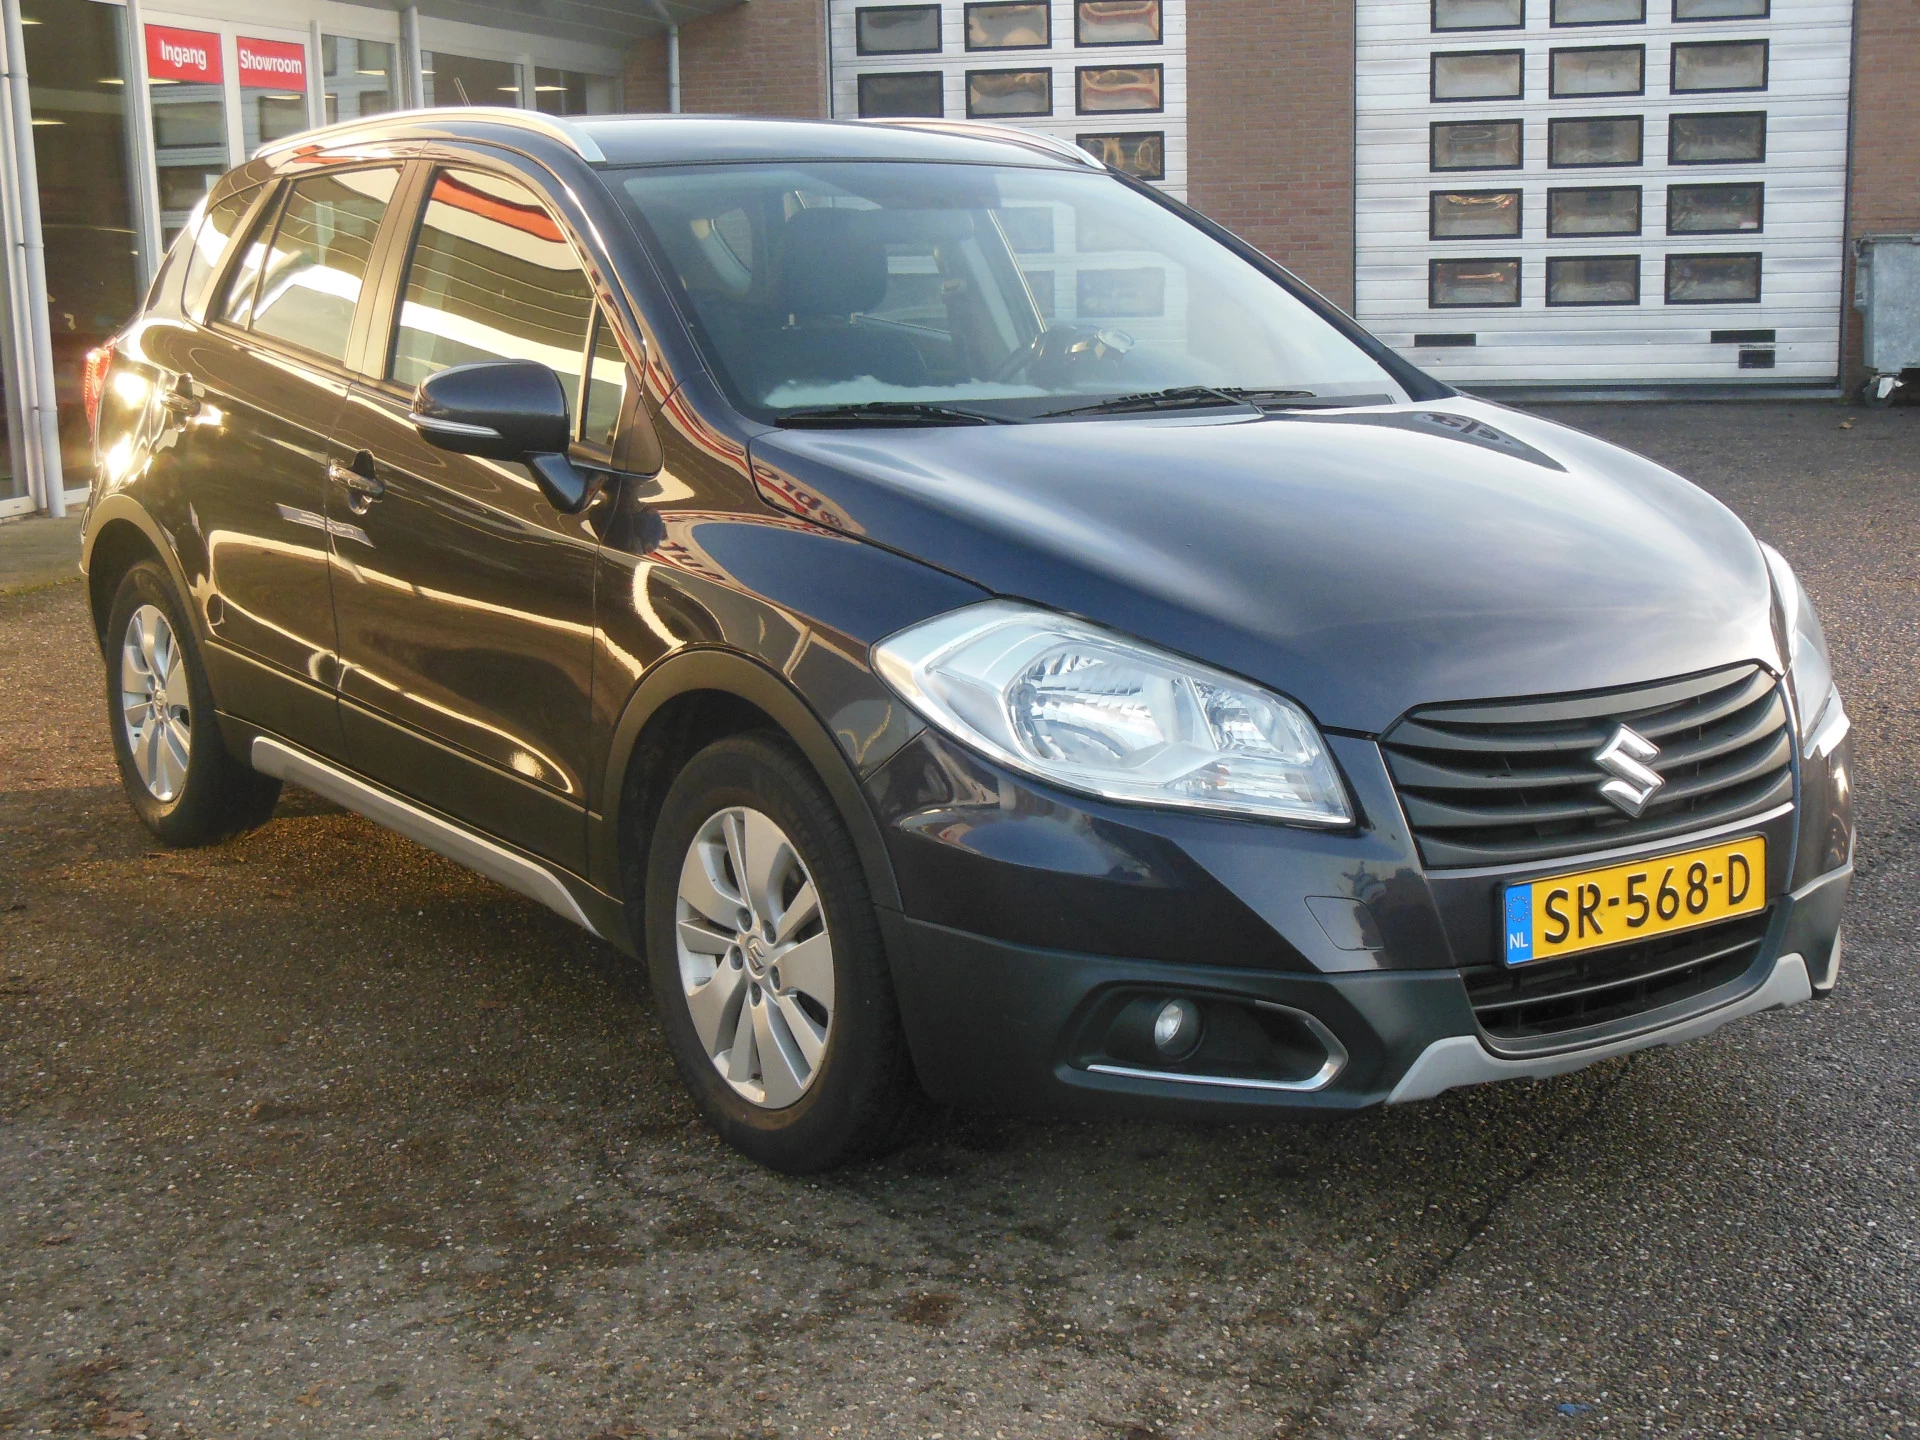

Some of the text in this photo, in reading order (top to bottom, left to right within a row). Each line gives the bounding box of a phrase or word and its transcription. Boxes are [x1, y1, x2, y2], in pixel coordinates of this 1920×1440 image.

[161, 39, 207, 71] Ingang
[240, 49, 303, 75] Showroom
[1544, 852, 1750, 944] SR-568-D
[1509, 931, 1529, 950] NL
